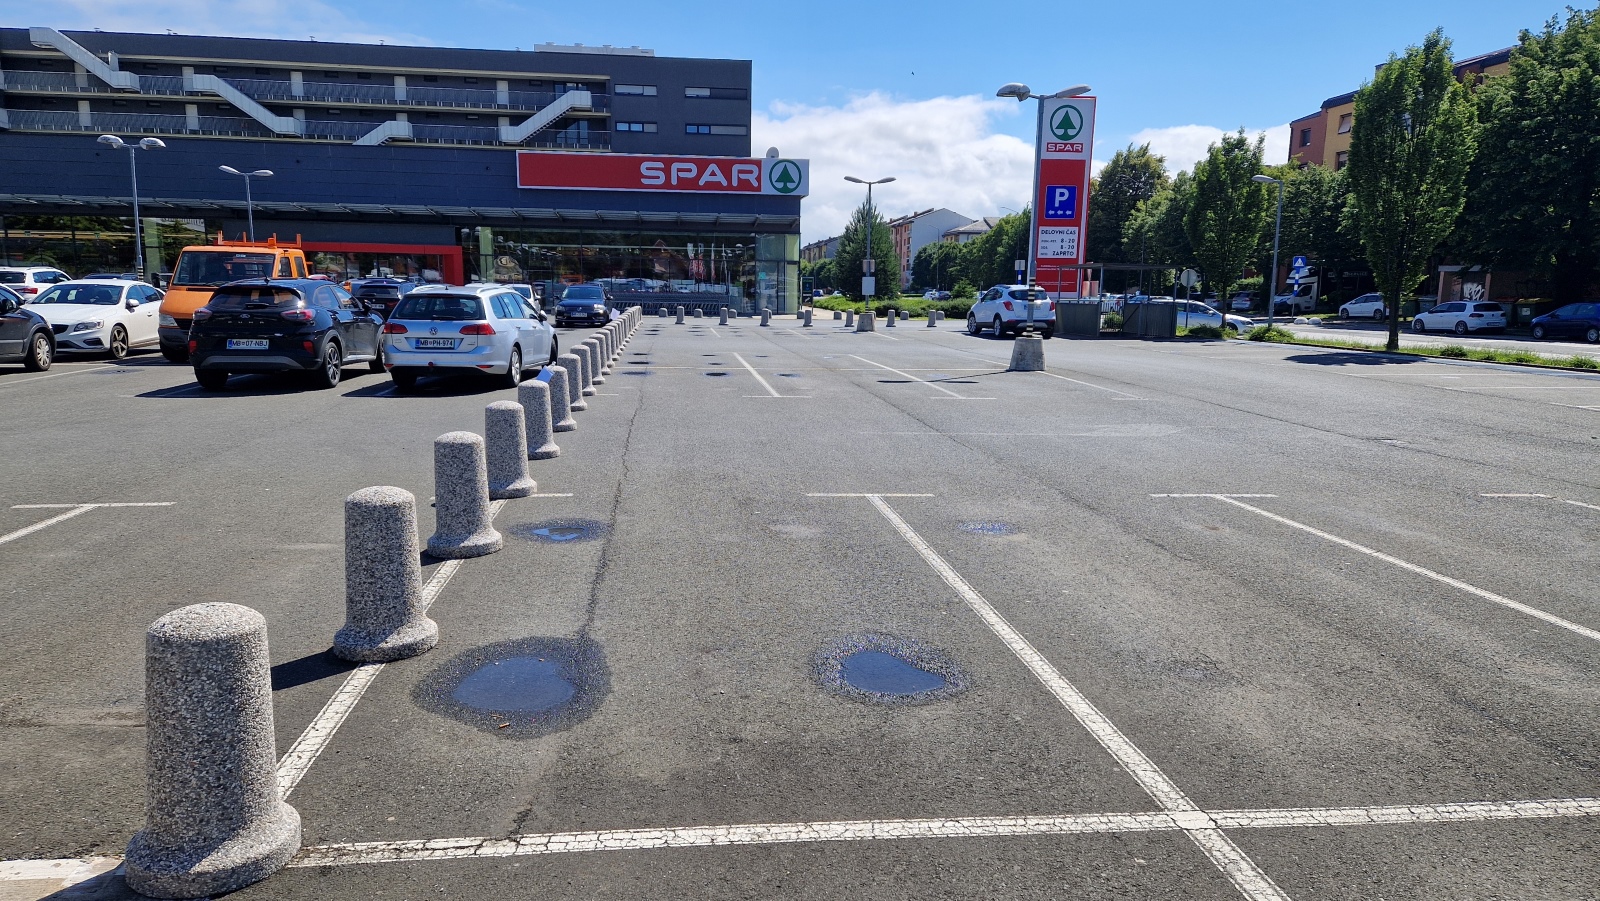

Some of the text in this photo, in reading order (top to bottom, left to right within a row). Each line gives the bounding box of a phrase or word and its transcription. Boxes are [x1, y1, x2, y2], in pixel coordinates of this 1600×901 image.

[1048, 143, 1083, 152] SPAR
[639, 161, 760, 188] SPAR
[1054, 188, 1070, 207] P
